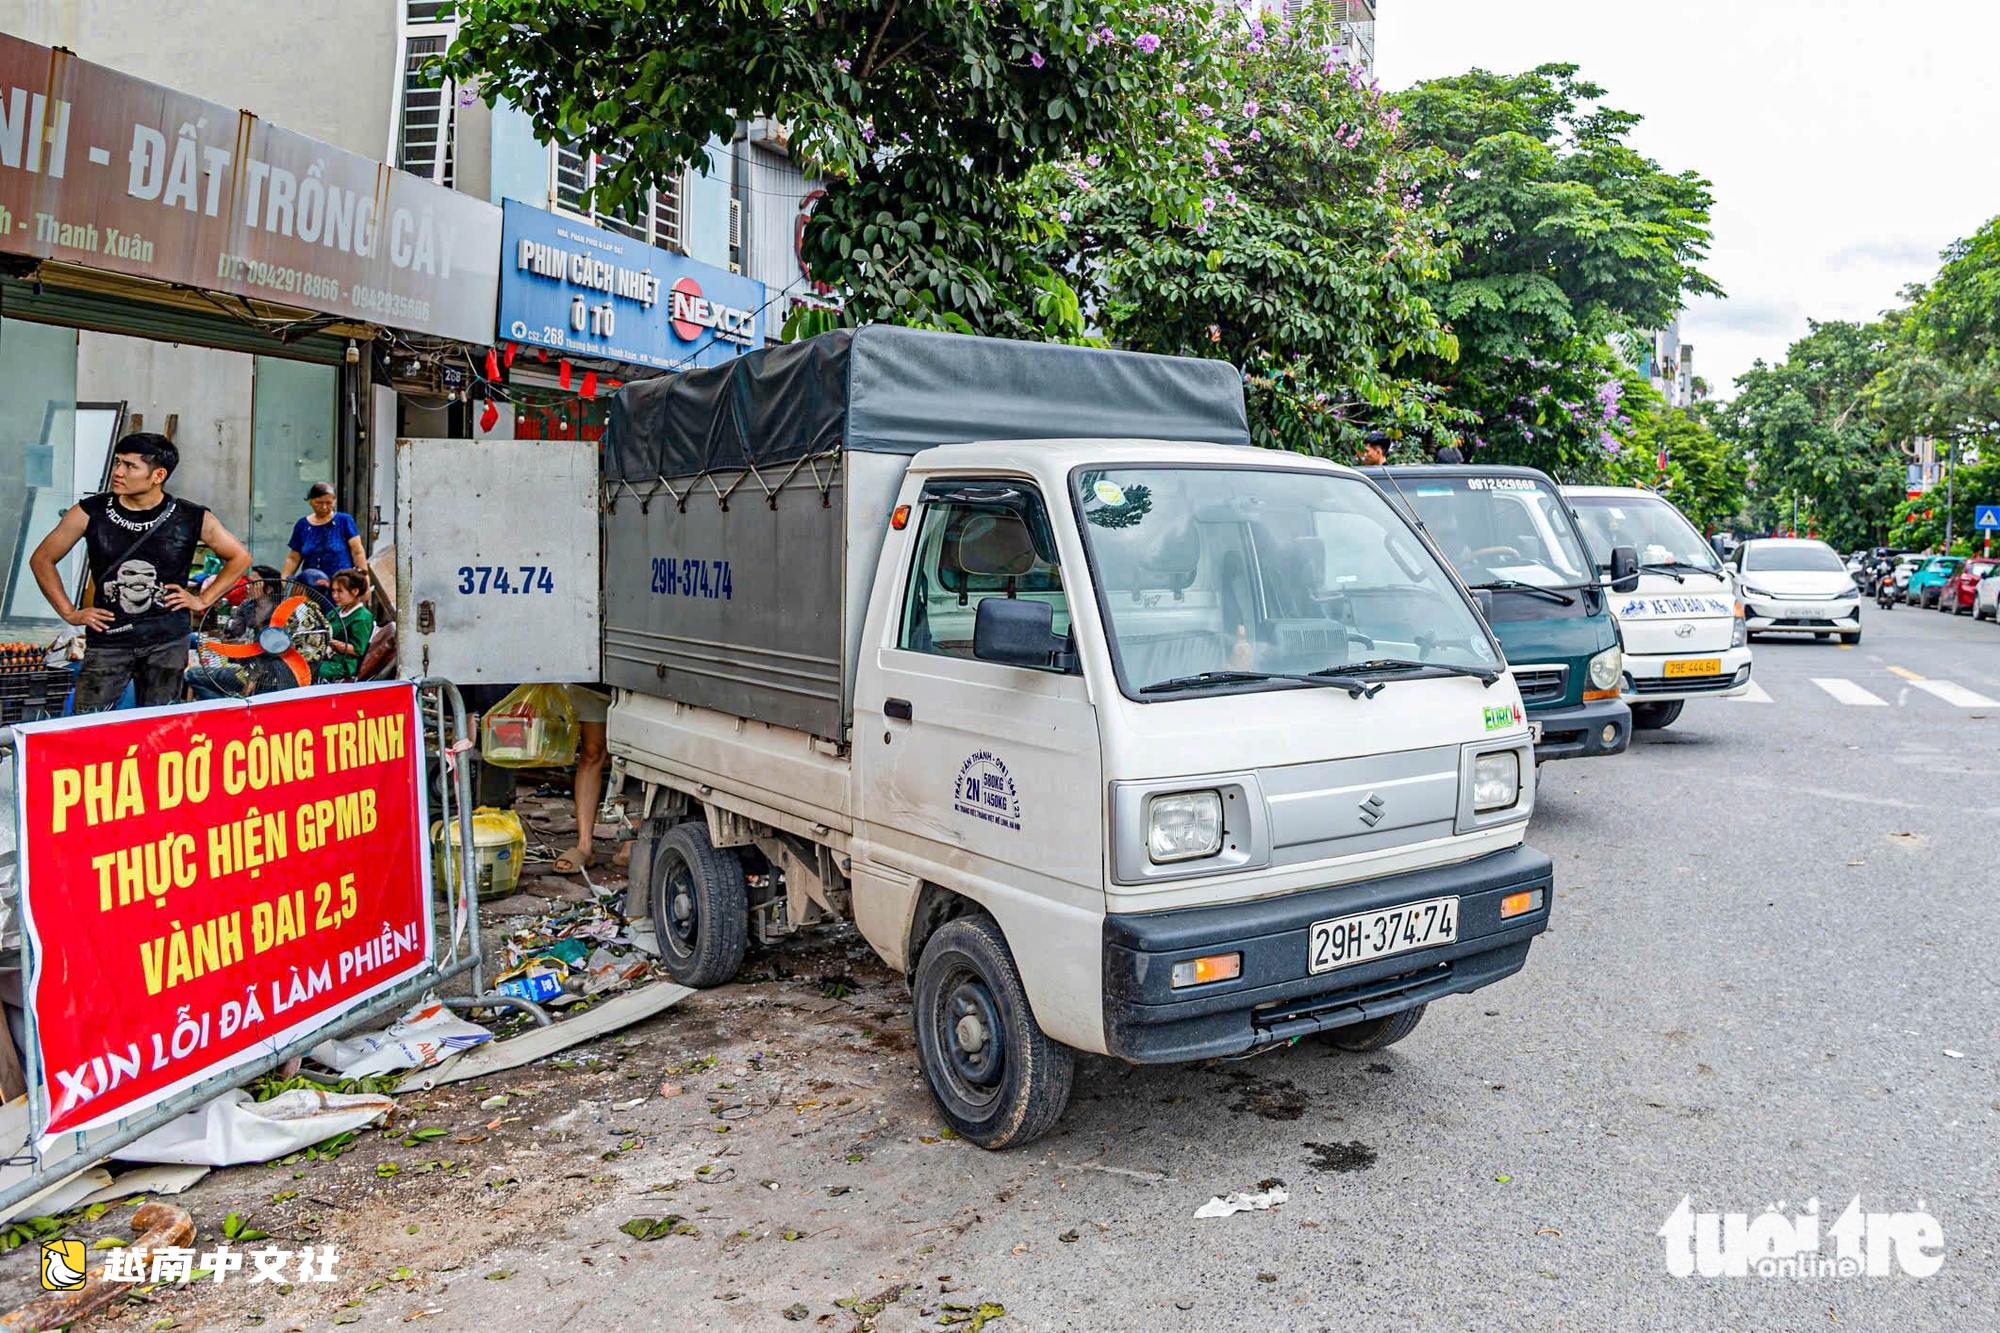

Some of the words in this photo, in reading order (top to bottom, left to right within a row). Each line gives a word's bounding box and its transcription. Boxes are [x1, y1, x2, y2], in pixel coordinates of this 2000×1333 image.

[128, 118, 230, 217] ĐẤT
[36, 212, 98, 252] Thanh
[104, 227, 154, 263] Xuân
[518, 239, 567, 280] PHIM
[568, 252, 614, 292] CÁCH
[615, 269, 661, 309] NHIỆT
[543, 326, 564, 346] 268
[674, 292, 755, 337] NEXCO
[458, 566, 554, 595] 374.74
[651, 557, 732, 601] 29H-374.74
[1651, 600, 1666, 615] XE
[52, 744, 145, 834] PHÁ
[158, 732, 214, 810] DỠ
[222, 725, 314, 795] CÔNG
[322, 710, 405, 773] TRÌNH
[966, 777, 980, 802] 2N
[983, 772, 1004, 791] 580KG
[983, 791, 1007, 811] 1450KG
[92, 831, 197, 912] THỰC
[208, 807, 287, 880] HIỆN
[296, 787, 378, 853] GPMB
[140, 909, 244, 996] VÀNH
[252, 889, 306, 955] ĐAI
[315, 872, 358, 931] 2,5
[1315, 904, 1453, 966] 29H-374.74
[55, 1042, 141, 1111] XIN
[152, 1004, 212, 1072] LỖI
[218, 987, 265, 1041] ĐÃ
[272, 957, 333, 1016] LÀM
[339, 920, 420, 985] PHIỀN!
